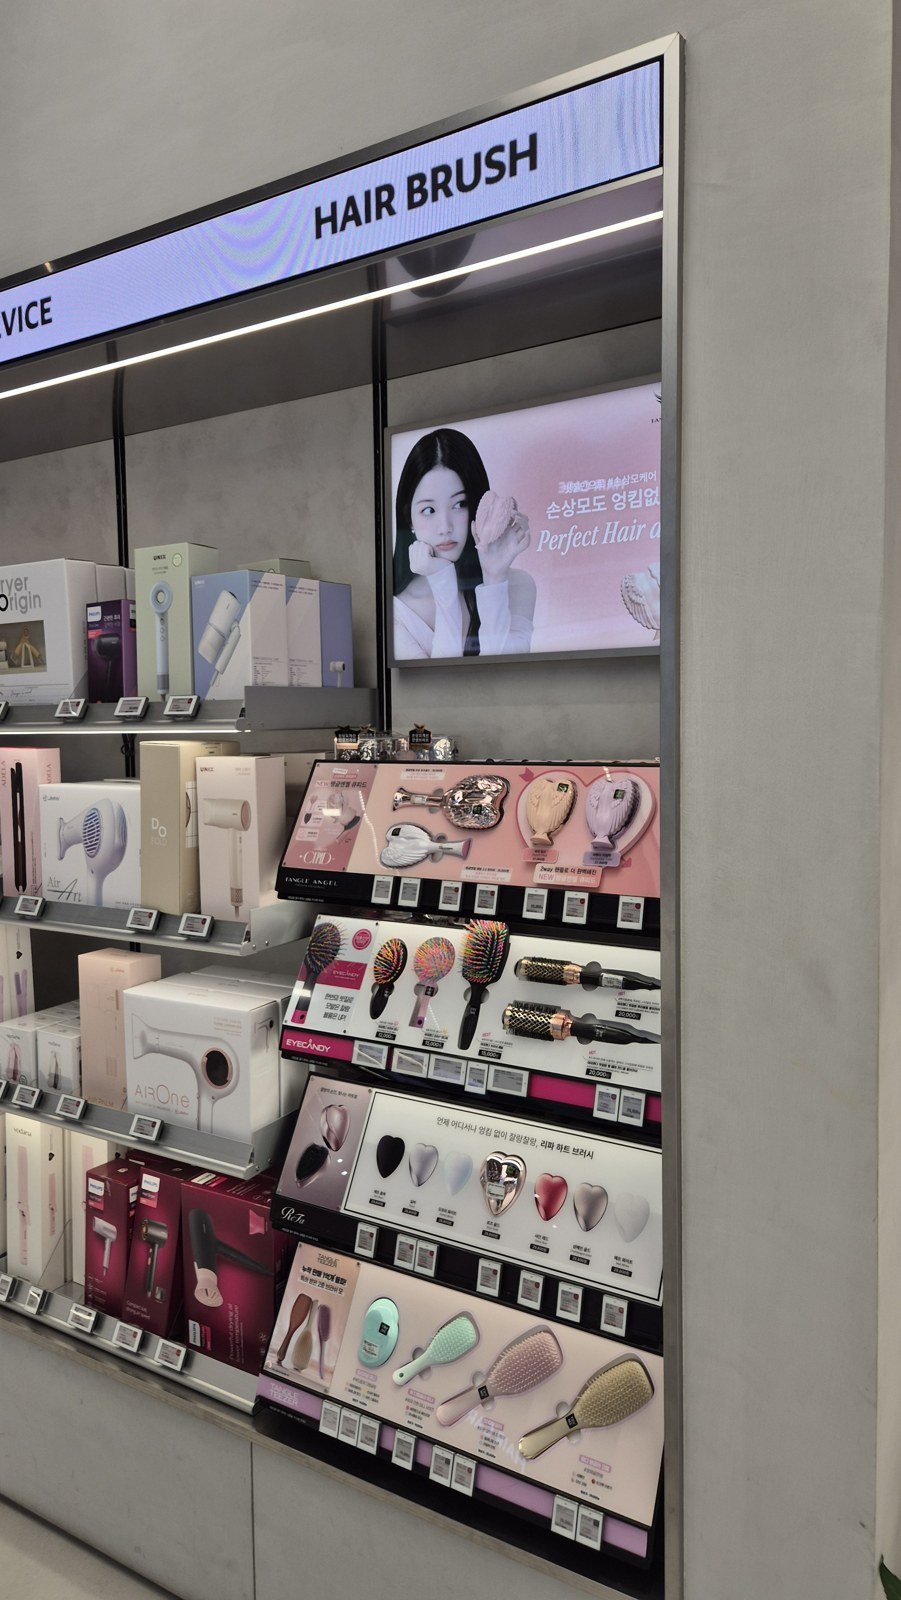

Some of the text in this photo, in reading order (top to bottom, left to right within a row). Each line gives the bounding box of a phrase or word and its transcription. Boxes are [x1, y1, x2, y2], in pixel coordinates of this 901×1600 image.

[315, 132, 538, 240] HAIR BRUSH
[0, 296, 53, 339] VICE
[546, 495, 607, 520] 손상모도
[536, 524, 600, 555] Perfect
[601, 519, 647, 545] Hair
[286, 1038, 331, 1053] EYECANDY
[436, 1116, 449, 1127] 언제
[450, 1120, 477, 1132] 어디서나
[478, 1126, 492, 1136] 엉킴
[493, 1128, 508, 1140] 없이
[540, 1139, 554, 1151] 리파
[556, 1143, 570, 1154] 하트
[571, 1147, 594, 1160] 브러시
